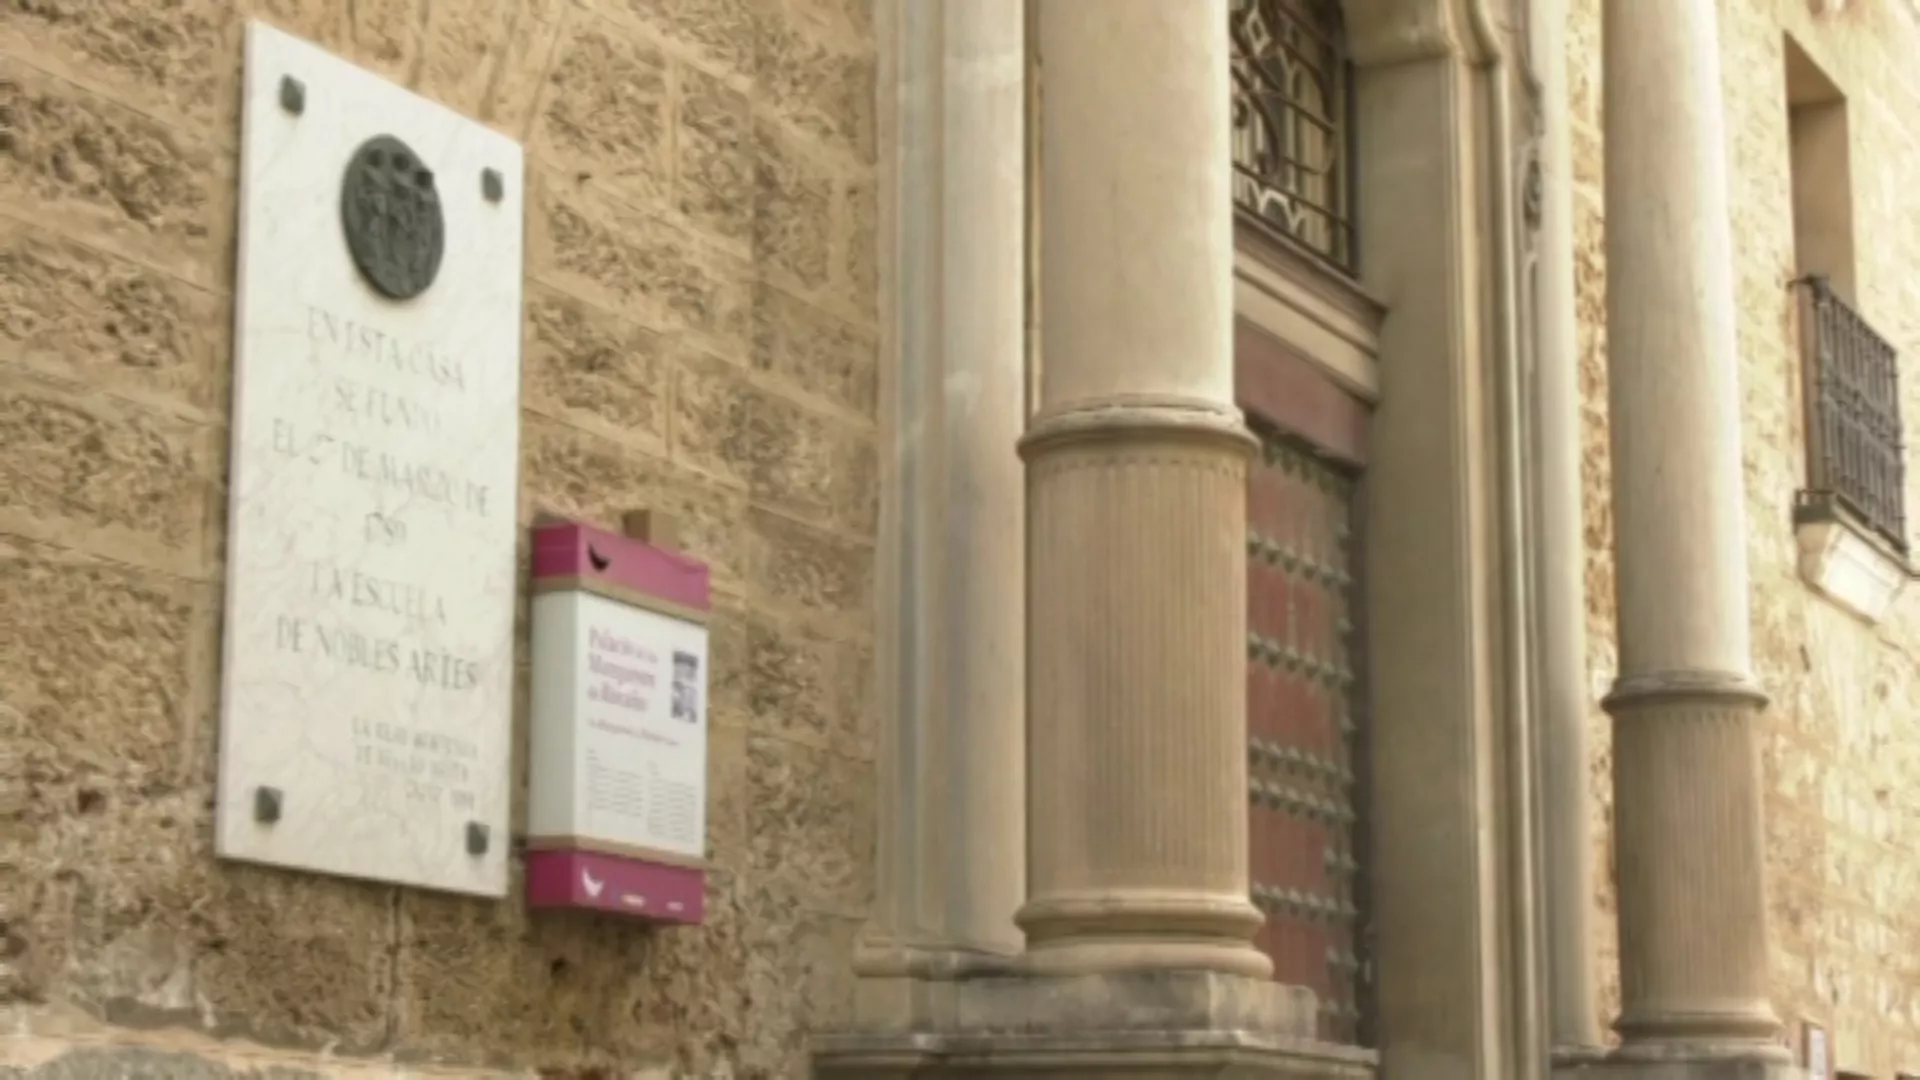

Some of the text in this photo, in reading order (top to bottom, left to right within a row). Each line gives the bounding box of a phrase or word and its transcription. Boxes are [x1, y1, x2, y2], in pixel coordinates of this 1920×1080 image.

[272, 416, 302, 460] EL
[341, 440, 373, 483] DE
[351, 570, 448, 628] ESCUELA
[276, 613, 479, 691] DE NOBLES ARTES
